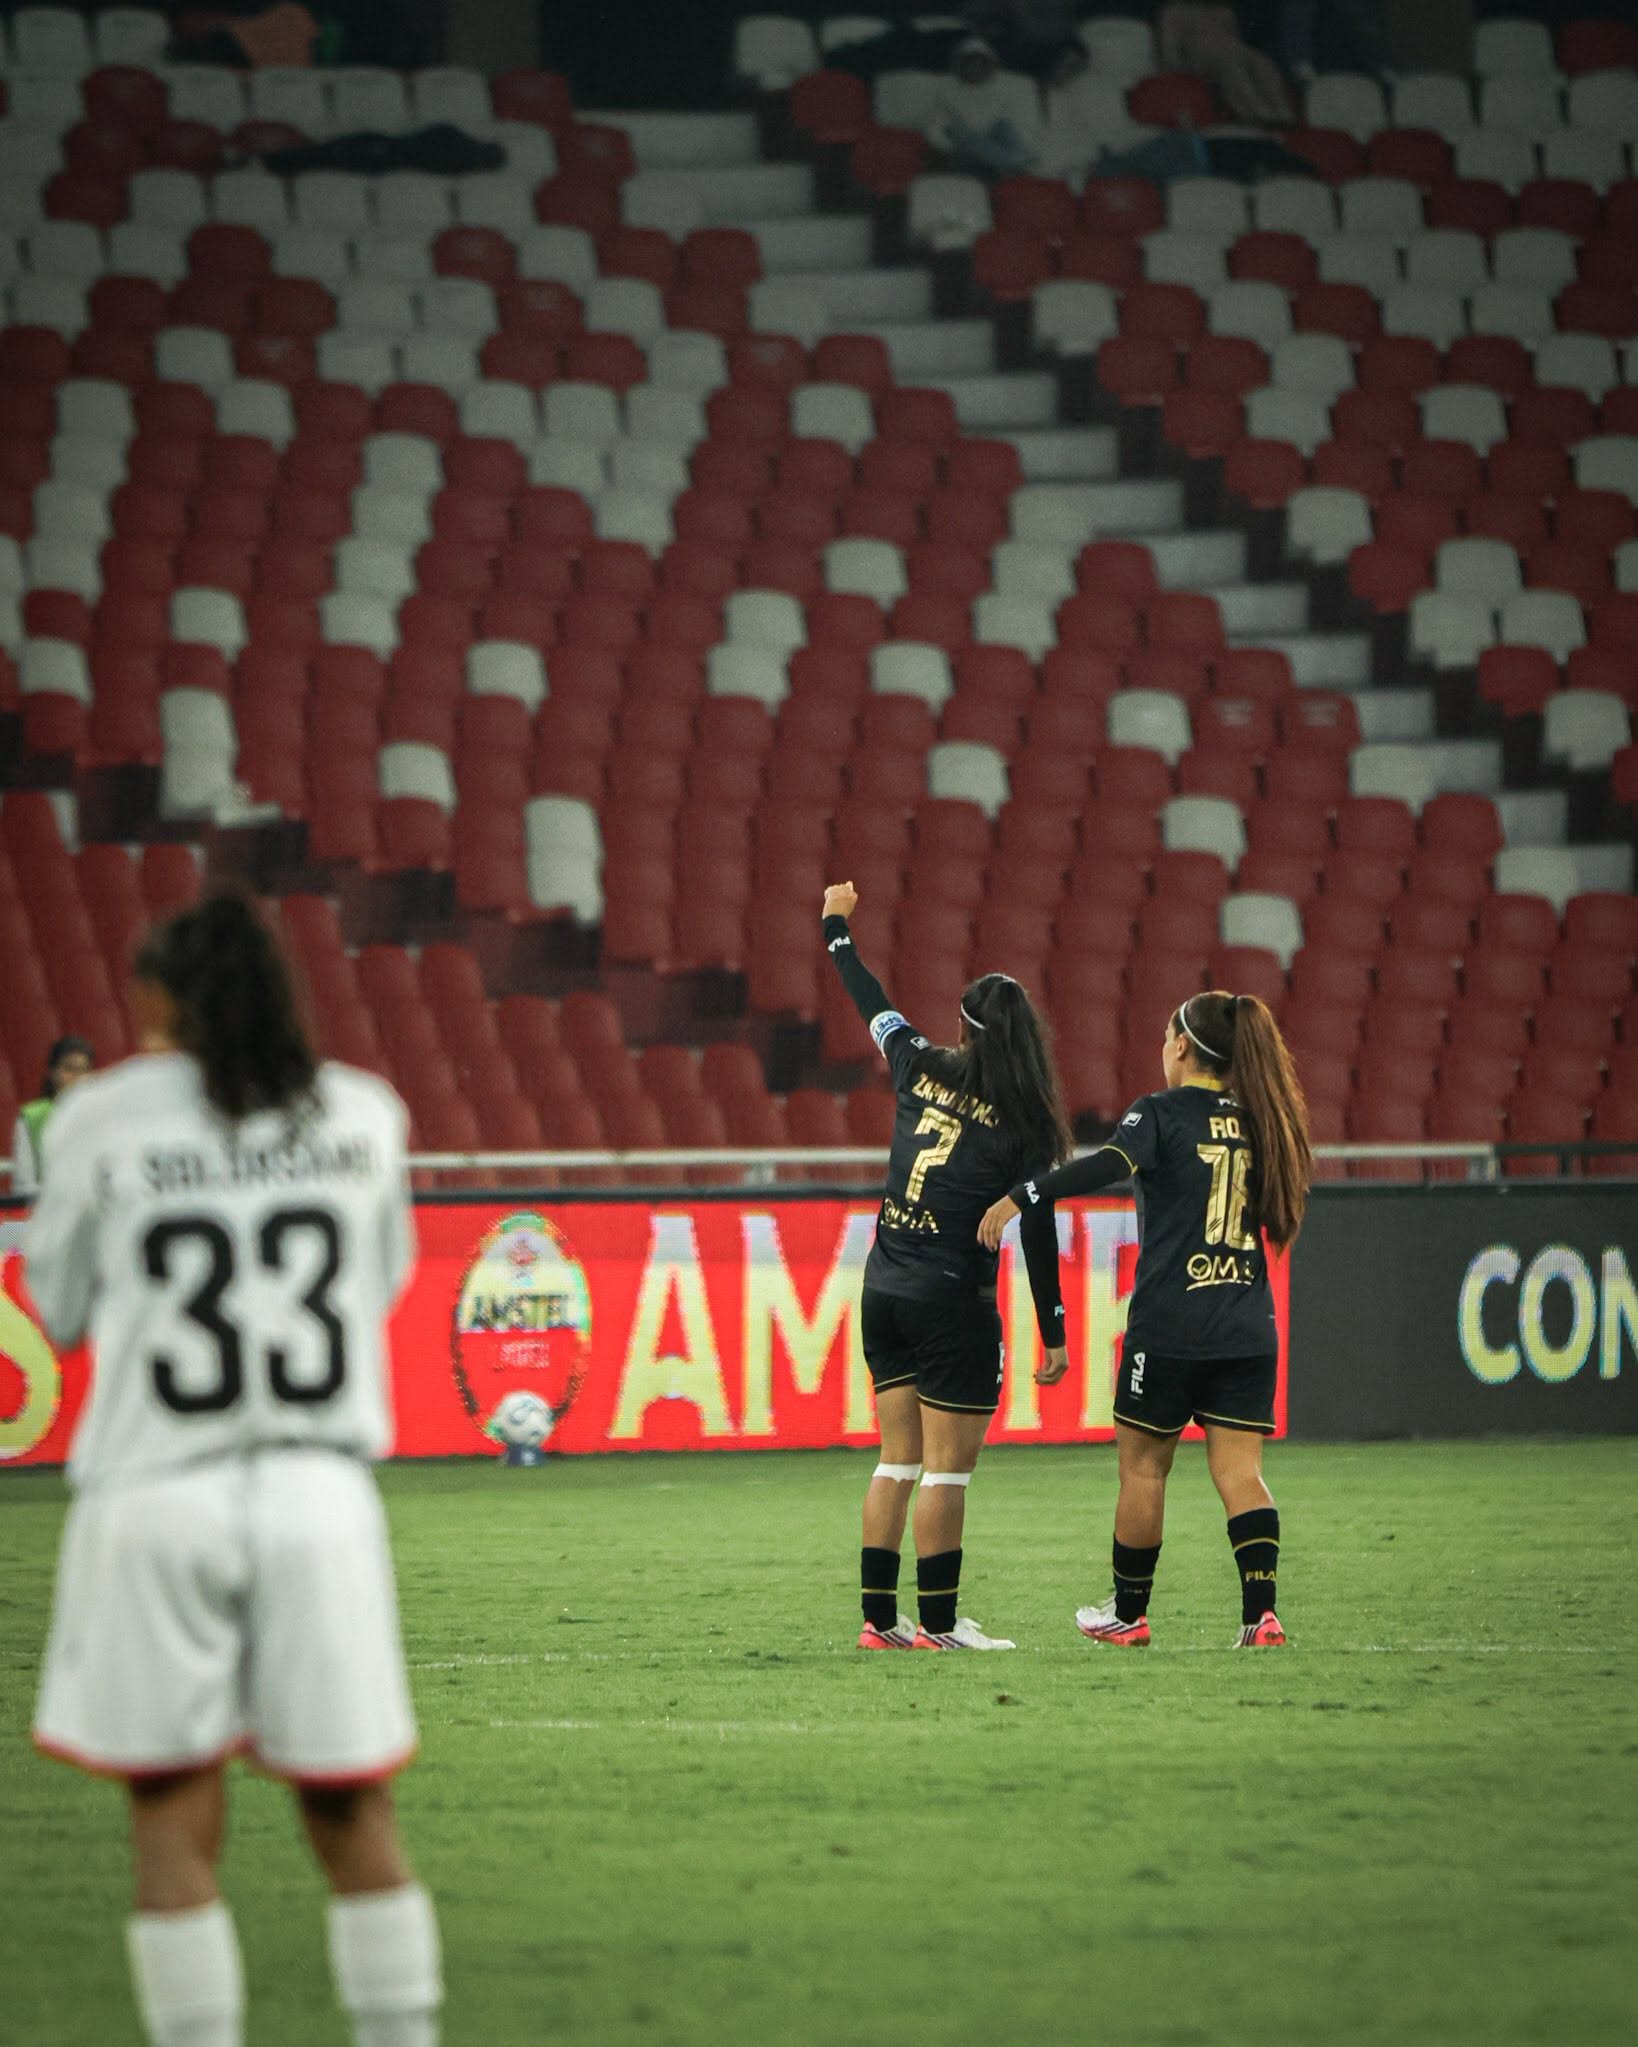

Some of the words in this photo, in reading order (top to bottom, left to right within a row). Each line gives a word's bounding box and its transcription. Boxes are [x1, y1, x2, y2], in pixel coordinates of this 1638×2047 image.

[905, 1106, 963, 1203] 7
[1024, 1180, 1042, 1205] FILA
[143, 1205, 346, 1415] 33
[1130, 1352, 1146, 1394] FILA
[1245, 1570, 1277, 1583] FILA
